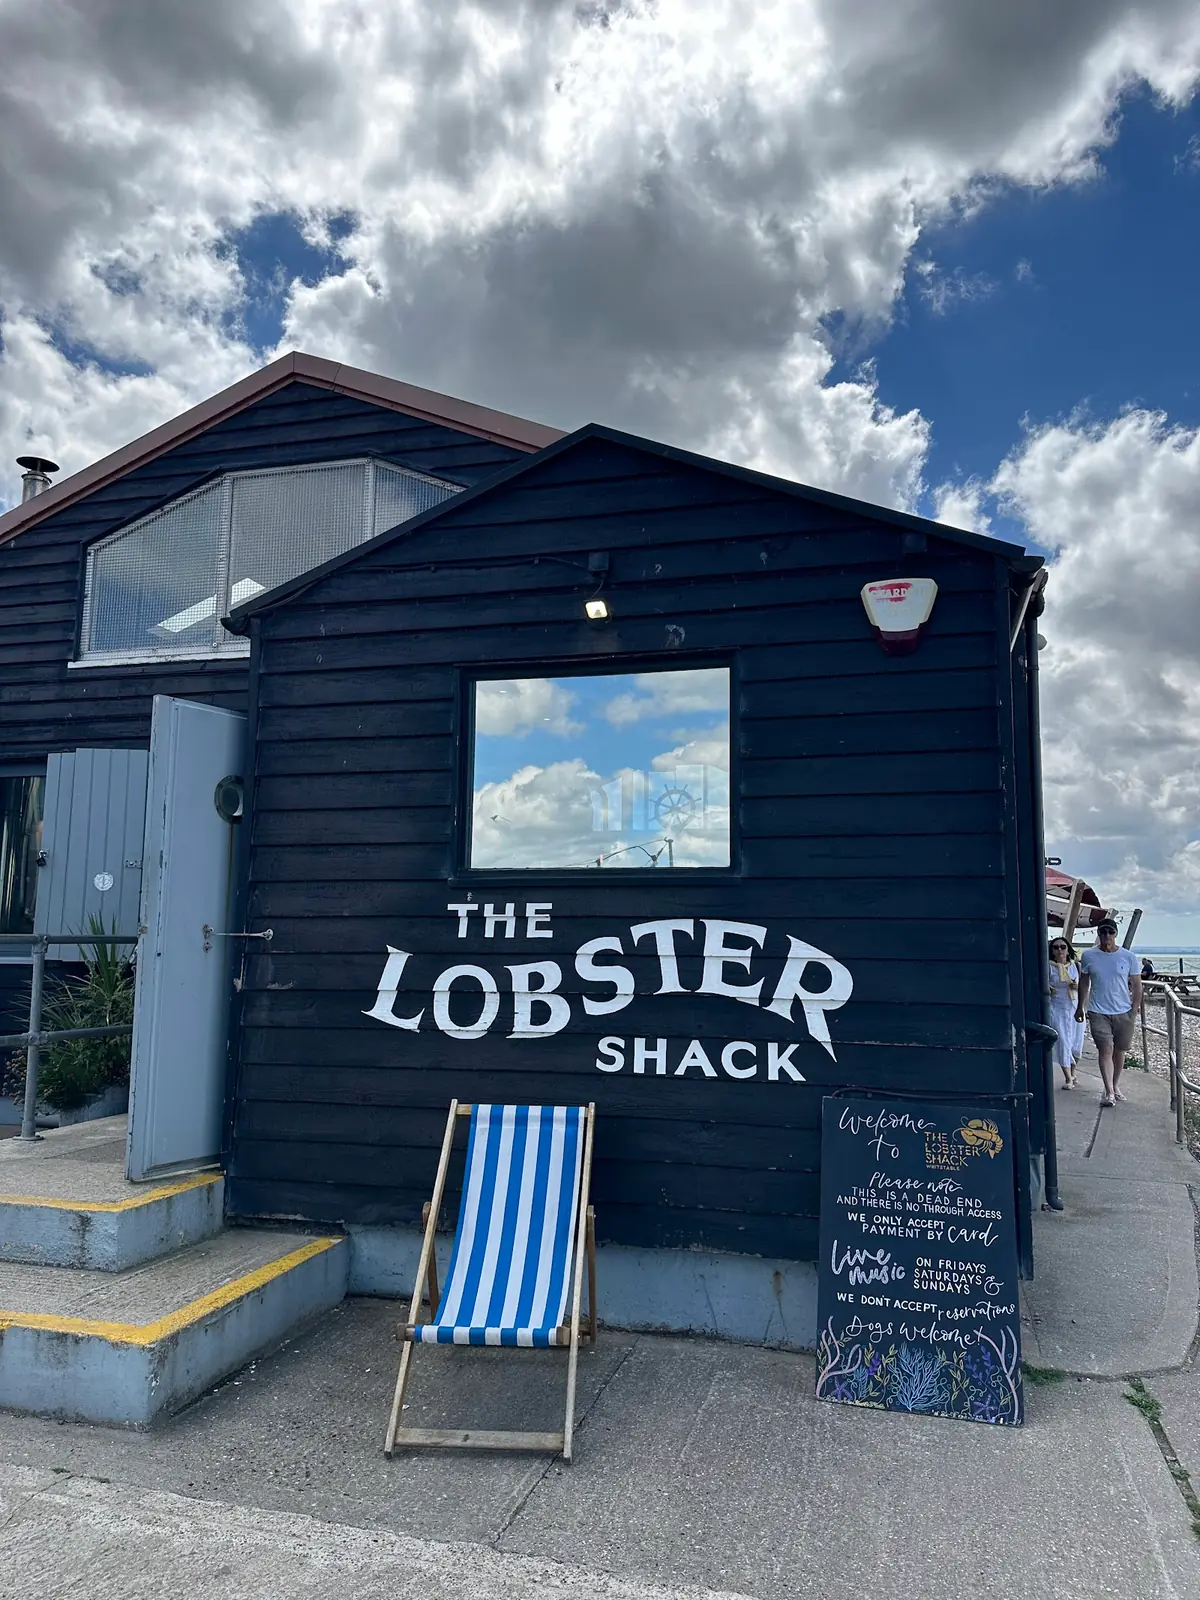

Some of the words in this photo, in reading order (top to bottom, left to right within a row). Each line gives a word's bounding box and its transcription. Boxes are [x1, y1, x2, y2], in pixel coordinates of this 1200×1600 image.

[447, 902, 553, 939] THE
[361, 918, 854, 1063] LOBSTER
[595, 1035, 807, 1082] SHACK
[839, 1106, 936, 1137] Welcome
[924, 1131, 948, 1143] THE
[924, 1142, 981, 1157] LOBSTER
[925, 1152, 969, 1167] SHACK
[869, 1171, 924, 1190] Please
[927, 1177, 964, 1195] note
[836, 1194, 858, 1206] AND
[860, 1197, 892, 1210] THERE
[894, 1201, 903, 1211] IS
[906, 1202, 920, 1212] NO
[922, 1203, 964, 1217] THROUGH
[967, 1208, 1002, 1220] ACCESS
[852, 1186, 877, 1198] THIS
[886, 1190, 897, 1201] IS
[901, 1191, 909, 1202] A
[917, 1193, 950, 1206] DEAD
[957, 1196, 982, 1209] END
[847, 1211, 866, 1223] WE
[873, 1214, 903, 1226] ONLY
[907, 1217, 945, 1230] ACCEPT
[862, 1223, 921, 1239] PAYMENT
[927, 1230, 944, 1241] BY
[831, 1239, 892, 1275] Live
[916, 1256, 932, 1268] ON
[938, 1259, 987, 1274] FRIDAYS
[913, 1279, 971, 1295] SUNDAYS
[914, 1268, 982, 1286] SATURDAYS
[836, 1292, 854, 1303] WE
[861, 1294, 891, 1307] DON'T
[893, 1299, 938, 1314] ACCEPT
[937, 1301, 1016, 1321] reservations
[845, 1315, 894, 1343] Dogs
